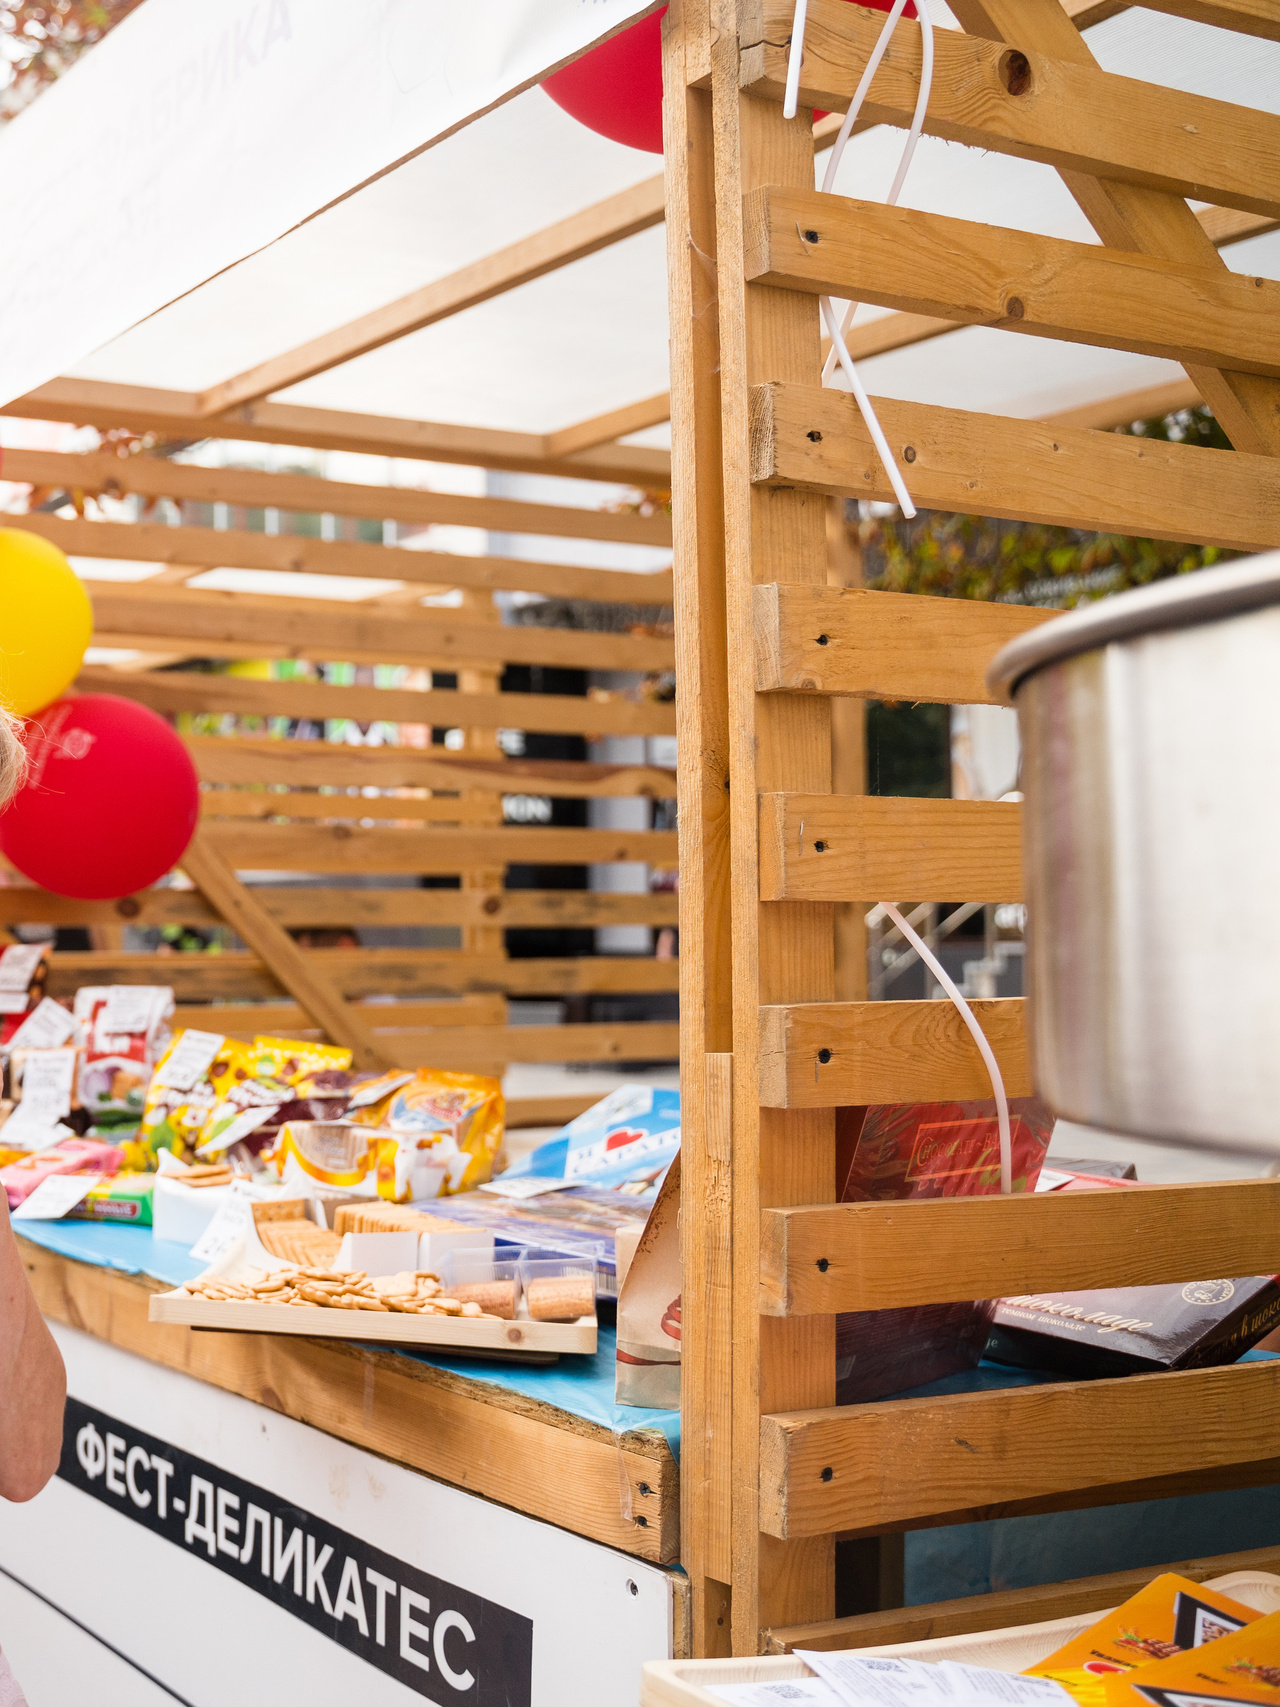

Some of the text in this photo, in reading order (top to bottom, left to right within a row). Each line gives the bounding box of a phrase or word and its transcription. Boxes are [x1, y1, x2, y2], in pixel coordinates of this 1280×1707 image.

[1001, 1307, 1086, 1332] темном шоколаде
[76, 1422, 476, 1691] ФЕСТ-ДЕЛИКАТЕС
